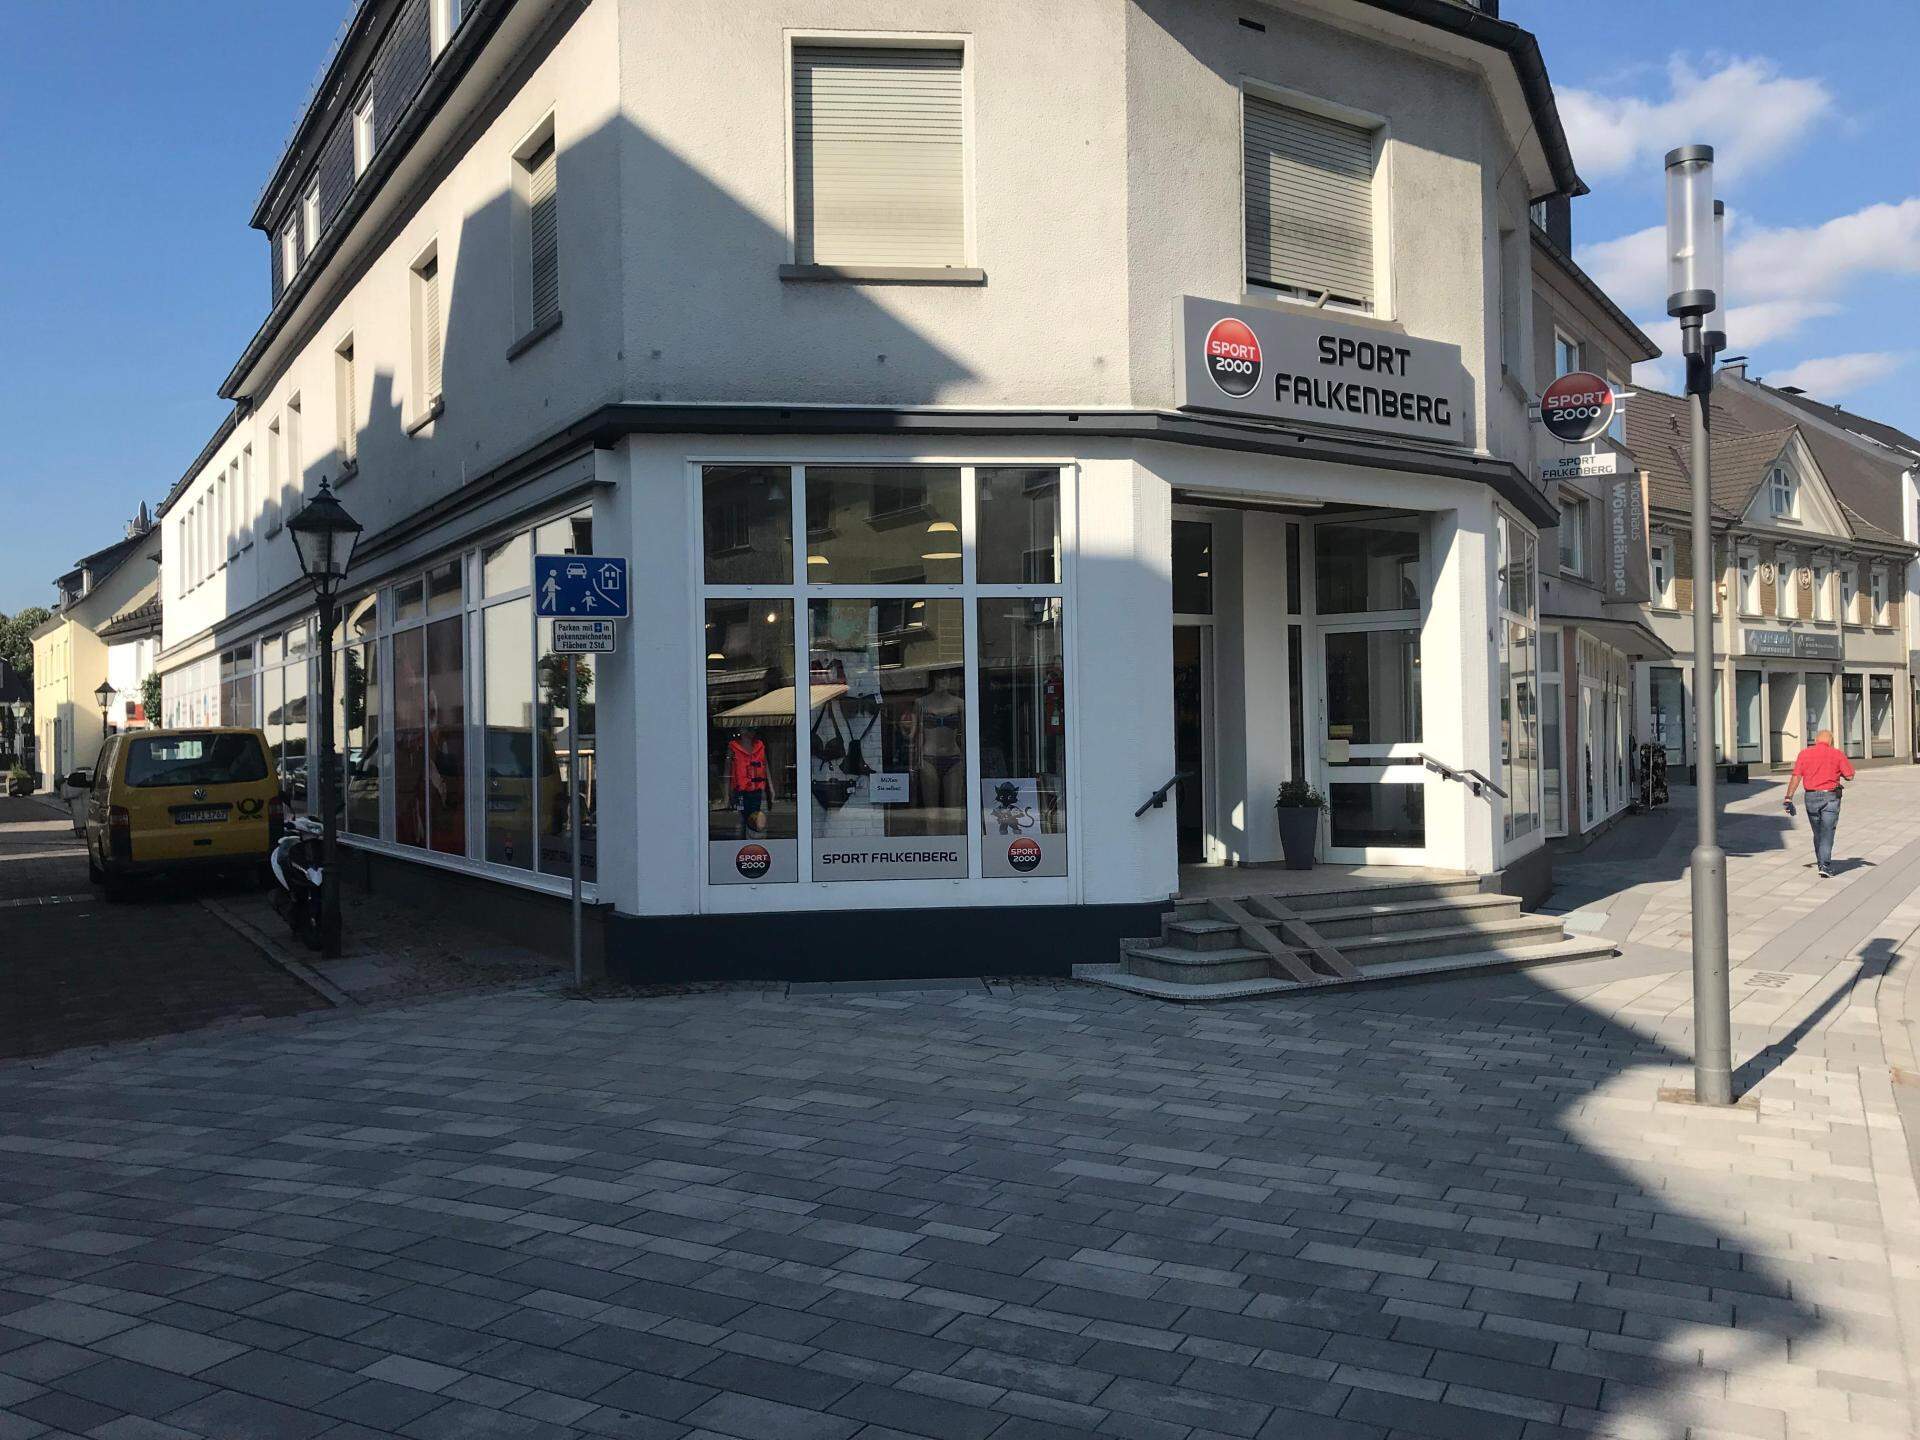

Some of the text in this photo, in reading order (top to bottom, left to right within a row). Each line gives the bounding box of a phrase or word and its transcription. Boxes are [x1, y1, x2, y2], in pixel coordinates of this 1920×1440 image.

[1211, 339, 1255, 358] SPORT
[1318, 335, 1411, 376] SPORT
[1216, 358, 1252, 374] 2000
[1274, 372, 1451, 426] FALKENBERG
[1548, 391, 1605, 408] SPORT
[1553, 406, 1601, 421] 2000
[1559, 455, 1596, 467] SPORT
[1542, 465, 1613, 479] FALKENBERG
[1631, 480, 1641, 542] Modehaus
[558, 623, 609, 631] Parken mit in
[556, 633, 612, 642] gekennzeichneten
[562, 641, 587, 649] Flächen
[822, 851, 958, 864] SPORT FALKENBERG
[1010, 848, 1039, 856] SPORT
[741, 861, 766, 869] 2000
